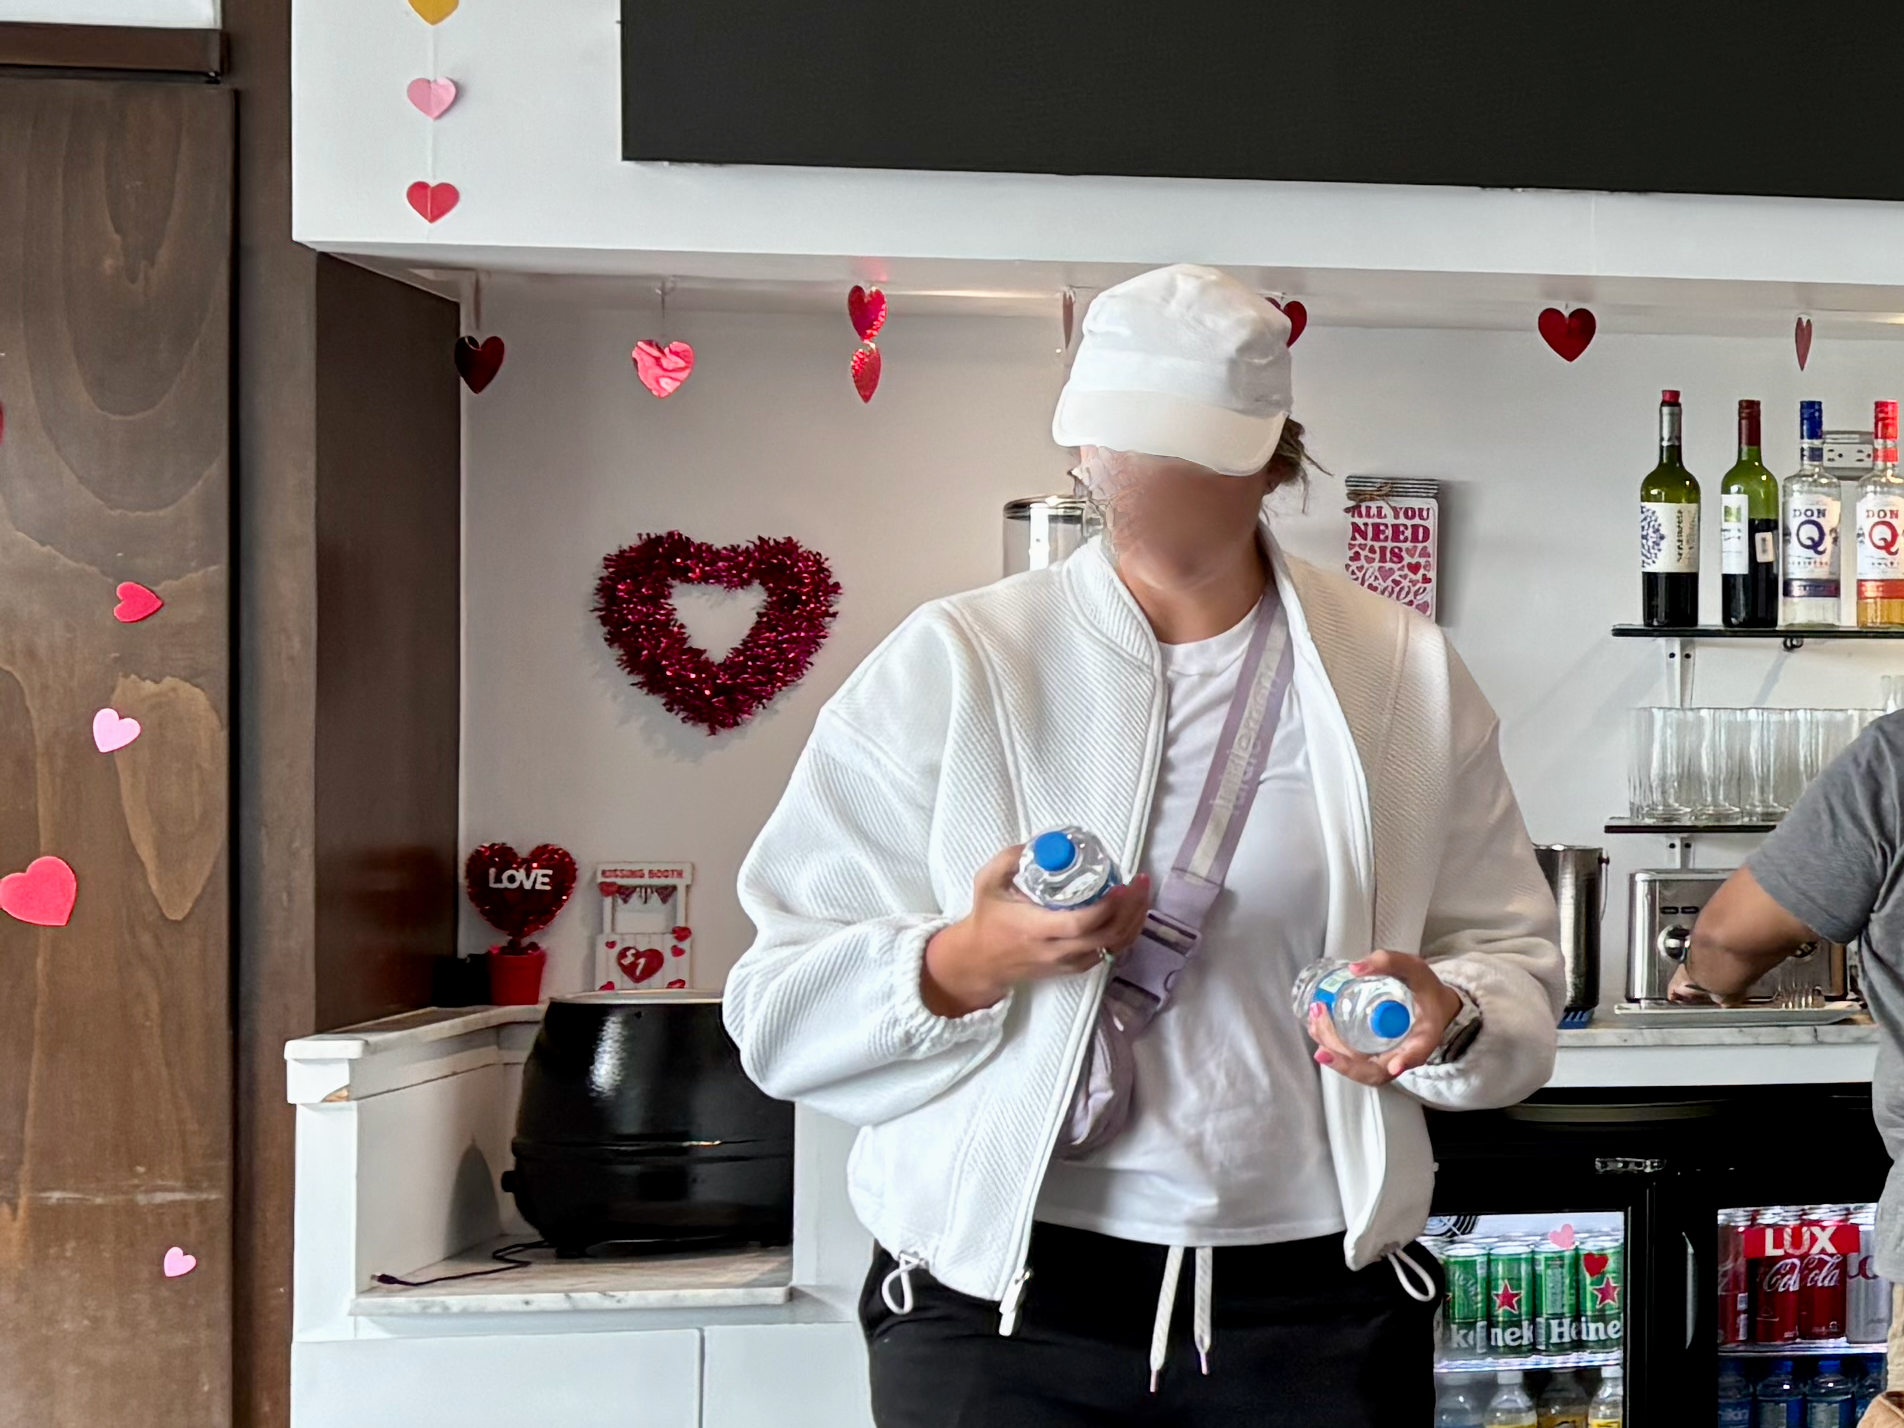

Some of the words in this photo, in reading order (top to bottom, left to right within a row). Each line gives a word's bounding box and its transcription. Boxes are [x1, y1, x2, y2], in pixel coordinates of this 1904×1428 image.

[1351, 504, 1388, 519] ALL
[1392, 506, 1431, 521] YOU
[1793, 508, 1827, 519] DON
[1866, 508, 1900, 520] DON
[1350, 521, 1431, 544] NEED
[1796, 519, 1827, 556] Q
[1869, 520, 1900, 556] Q
[1378, 545, 1405, 565] IS
[489, 865, 554, 891] LOVE
[1765, 1226, 1838, 1257] LUX
